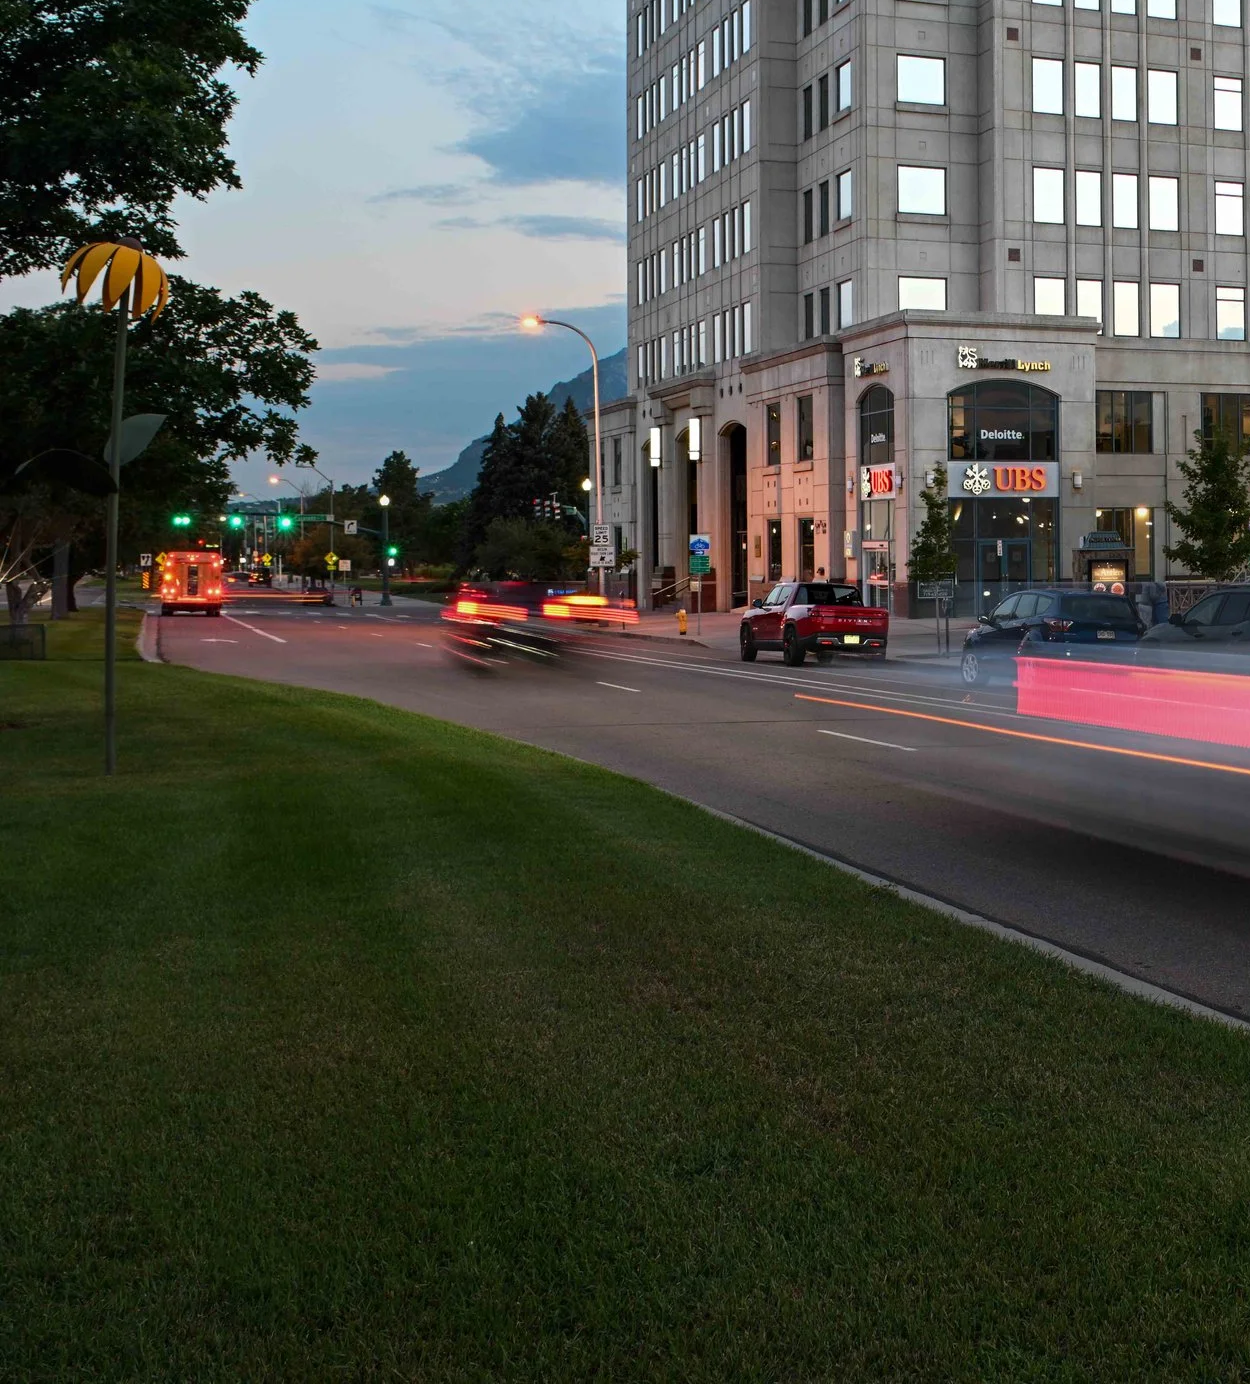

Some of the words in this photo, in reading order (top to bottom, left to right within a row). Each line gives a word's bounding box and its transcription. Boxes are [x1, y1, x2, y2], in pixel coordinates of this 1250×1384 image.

[1017, 359, 1051, 371] Lynch
[870, 469, 893, 493] UBS
[993, 466, 1047, 492] UBS
[594, 535, 608, 543] 25
